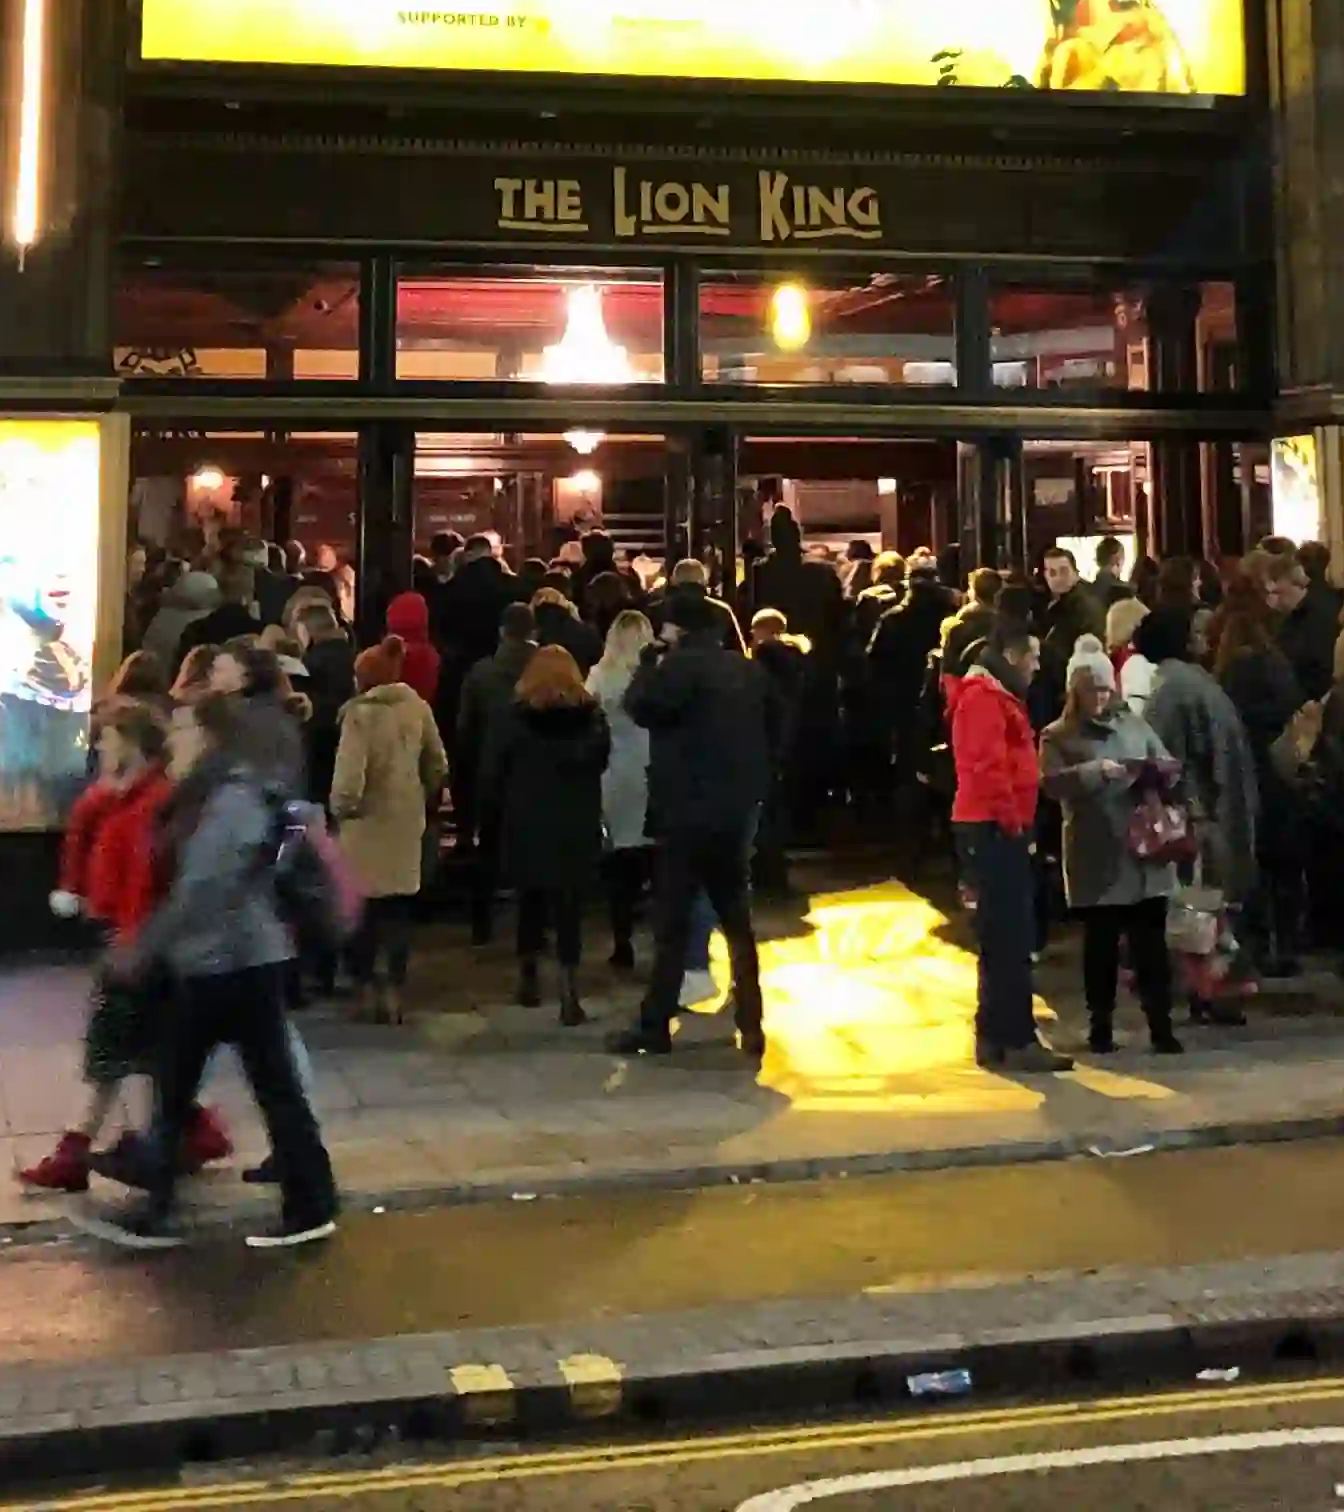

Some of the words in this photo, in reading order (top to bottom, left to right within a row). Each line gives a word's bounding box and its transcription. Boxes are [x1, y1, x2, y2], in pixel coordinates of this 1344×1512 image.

[397, 11, 498, 27] SUPPORTED
[506, 15, 527, 28] BY
[495, 177, 583, 224] THE
